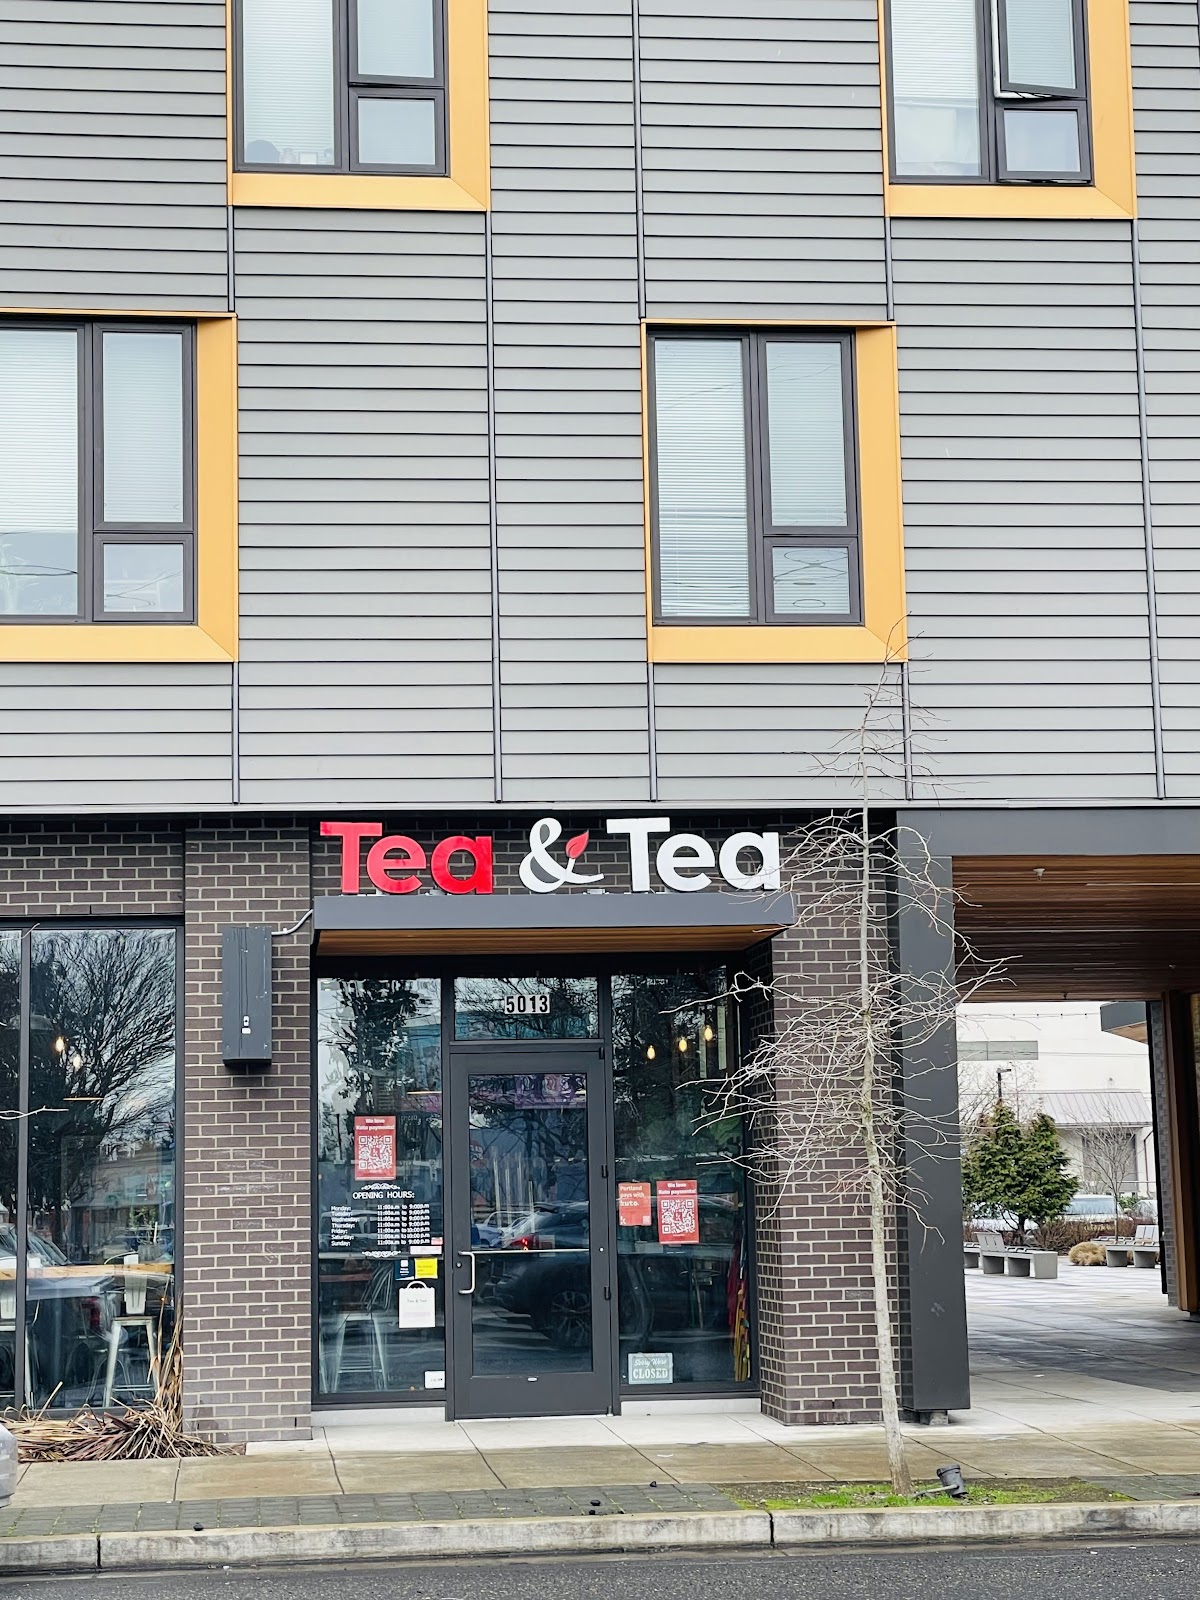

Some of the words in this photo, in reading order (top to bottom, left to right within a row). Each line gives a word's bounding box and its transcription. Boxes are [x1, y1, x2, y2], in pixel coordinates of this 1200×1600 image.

[319, 821, 494, 895] Tea
[518, 817, 605, 893] &
[606, 817, 781, 892] Tea
[506, 995, 548, 1013] 5013
[352, 1192, 384, 1200] OPENING
[632, 1368, 668, 1379] CLOSED
